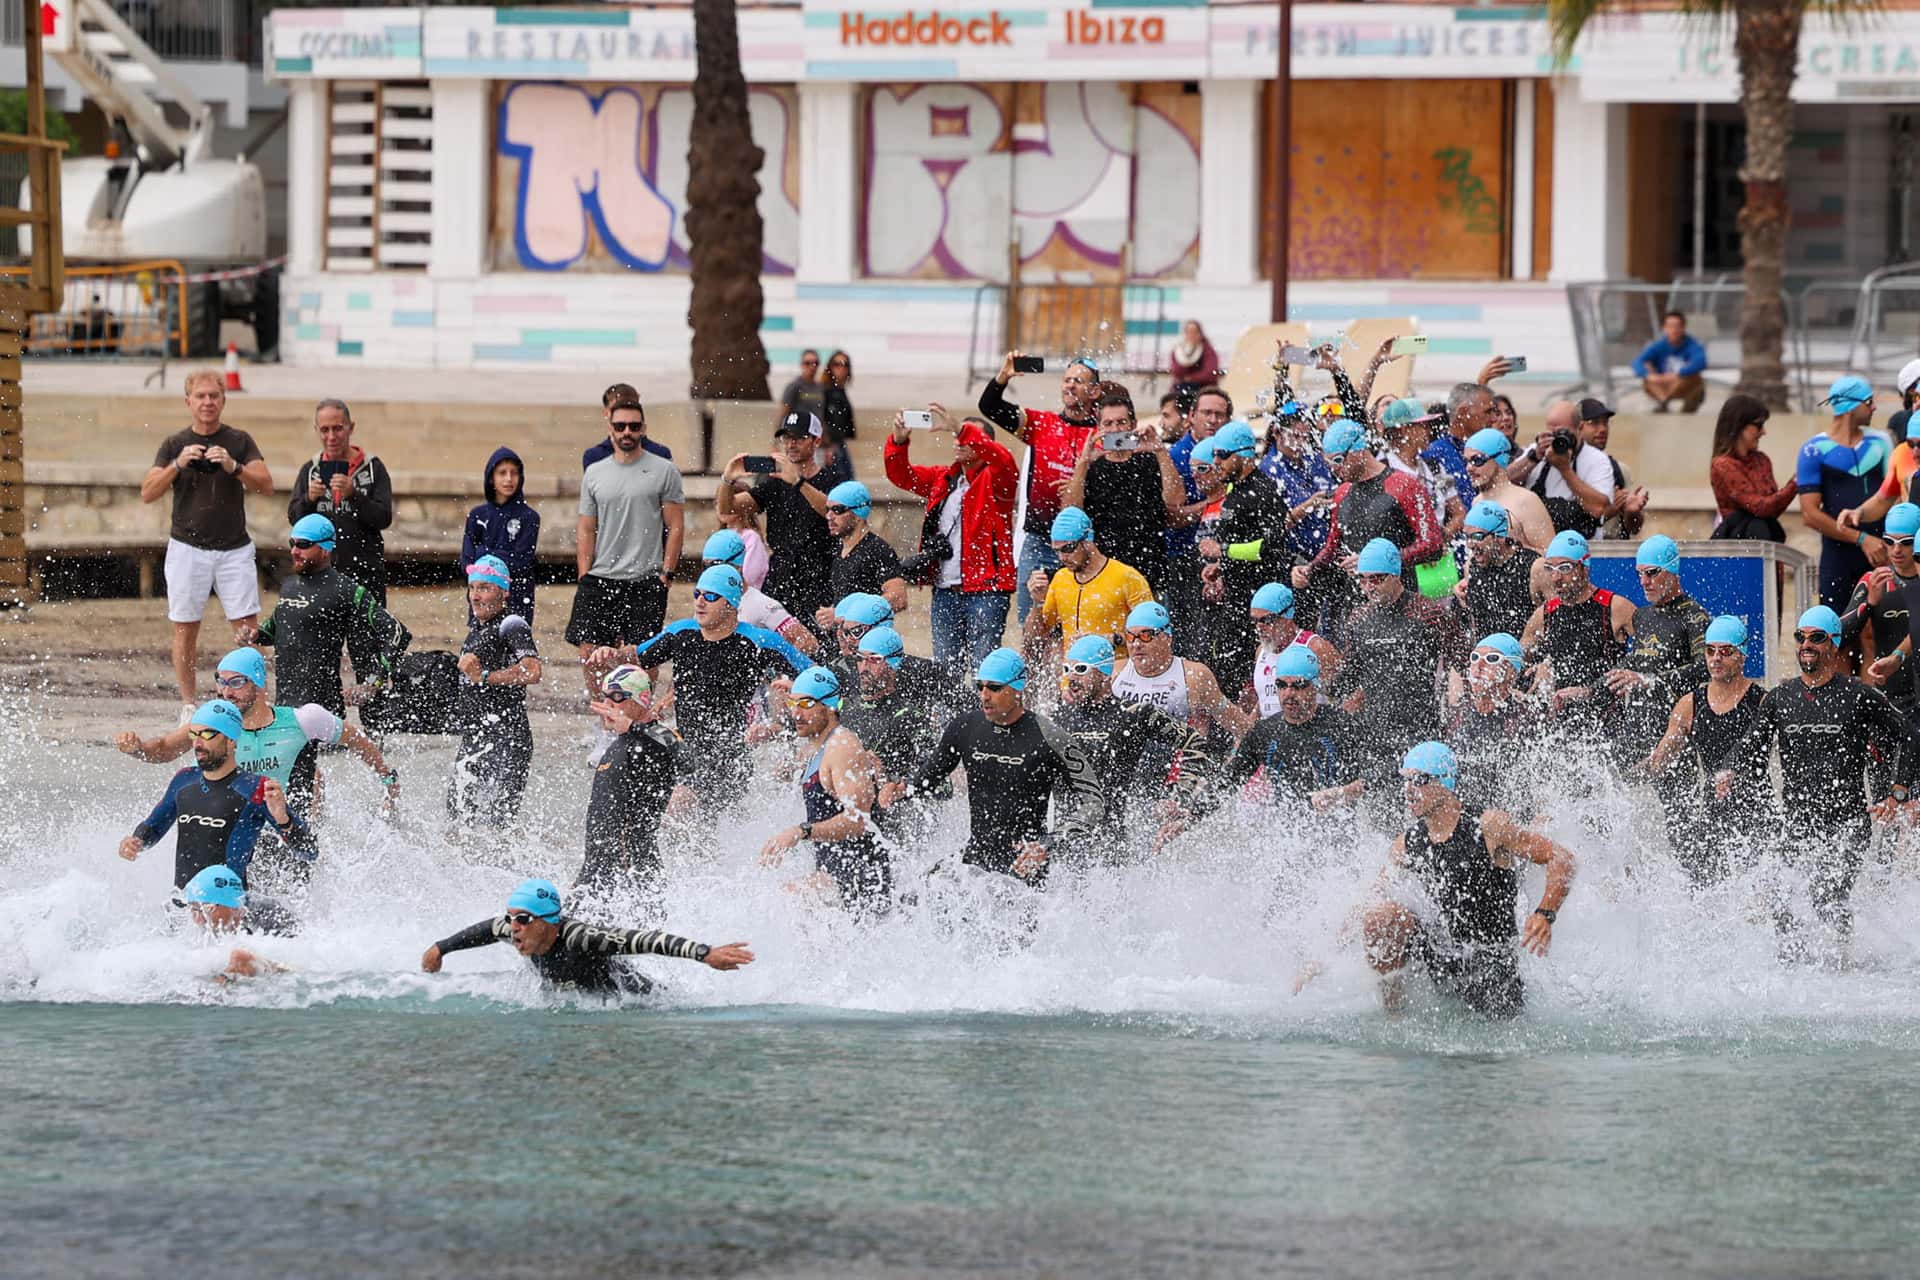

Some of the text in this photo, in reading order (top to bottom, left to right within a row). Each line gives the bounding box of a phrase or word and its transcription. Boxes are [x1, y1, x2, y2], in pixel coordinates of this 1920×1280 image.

[840, 9, 1165, 46] Haddock Ibiza
[239, 755, 280, 773] ZAMORA
[178, 813, 227, 829] orca
